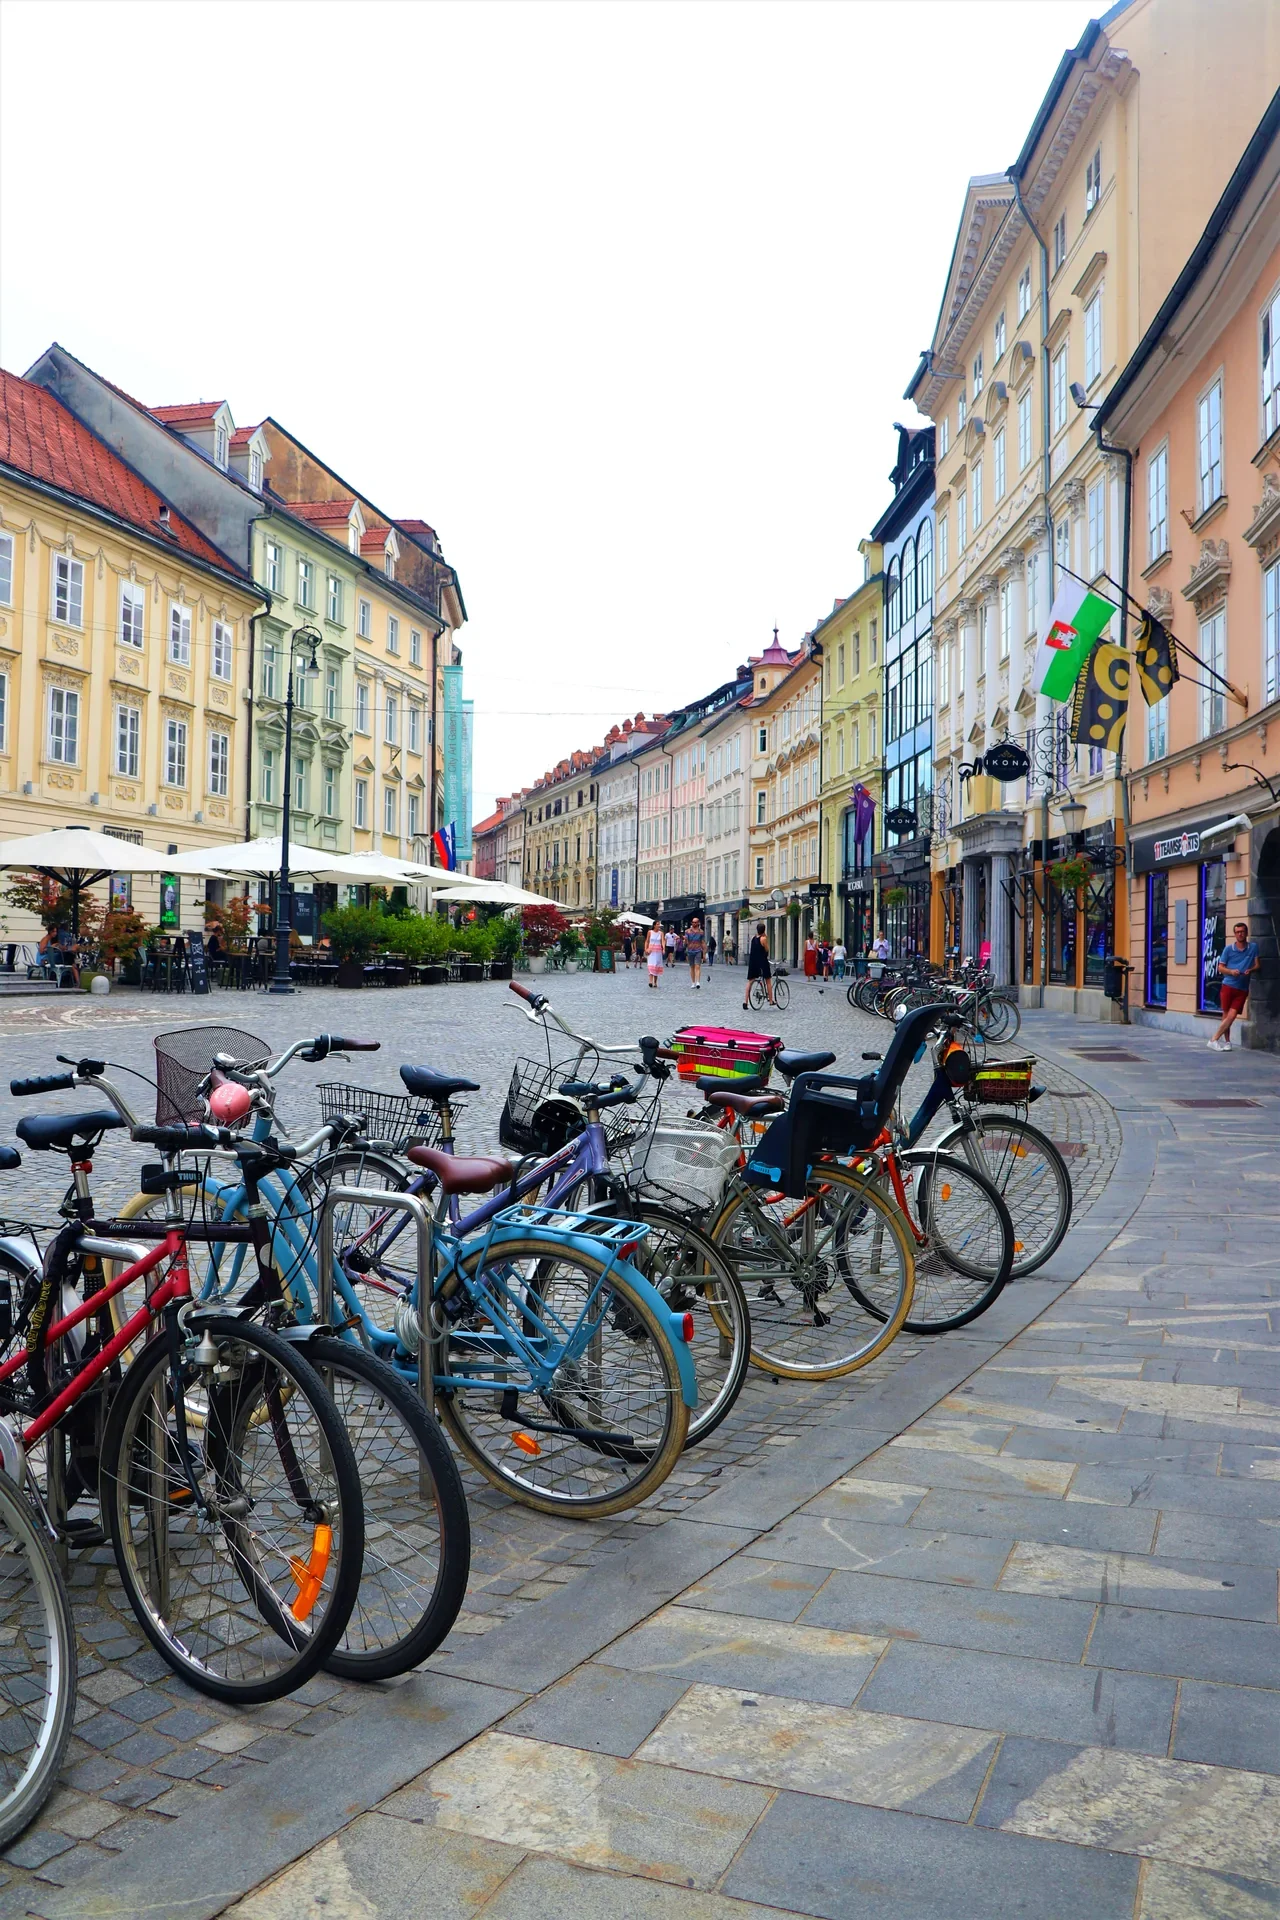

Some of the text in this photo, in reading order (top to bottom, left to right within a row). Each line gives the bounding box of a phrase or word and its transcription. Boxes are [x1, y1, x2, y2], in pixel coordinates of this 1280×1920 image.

[447, 713, 459, 740] Gallery
[447, 743, 457, 756] Art
[447, 757, 458, 773] City
[985, 759, 1029, 767] IKONA
[27, 1278, 52, 1353] ONGUARD
